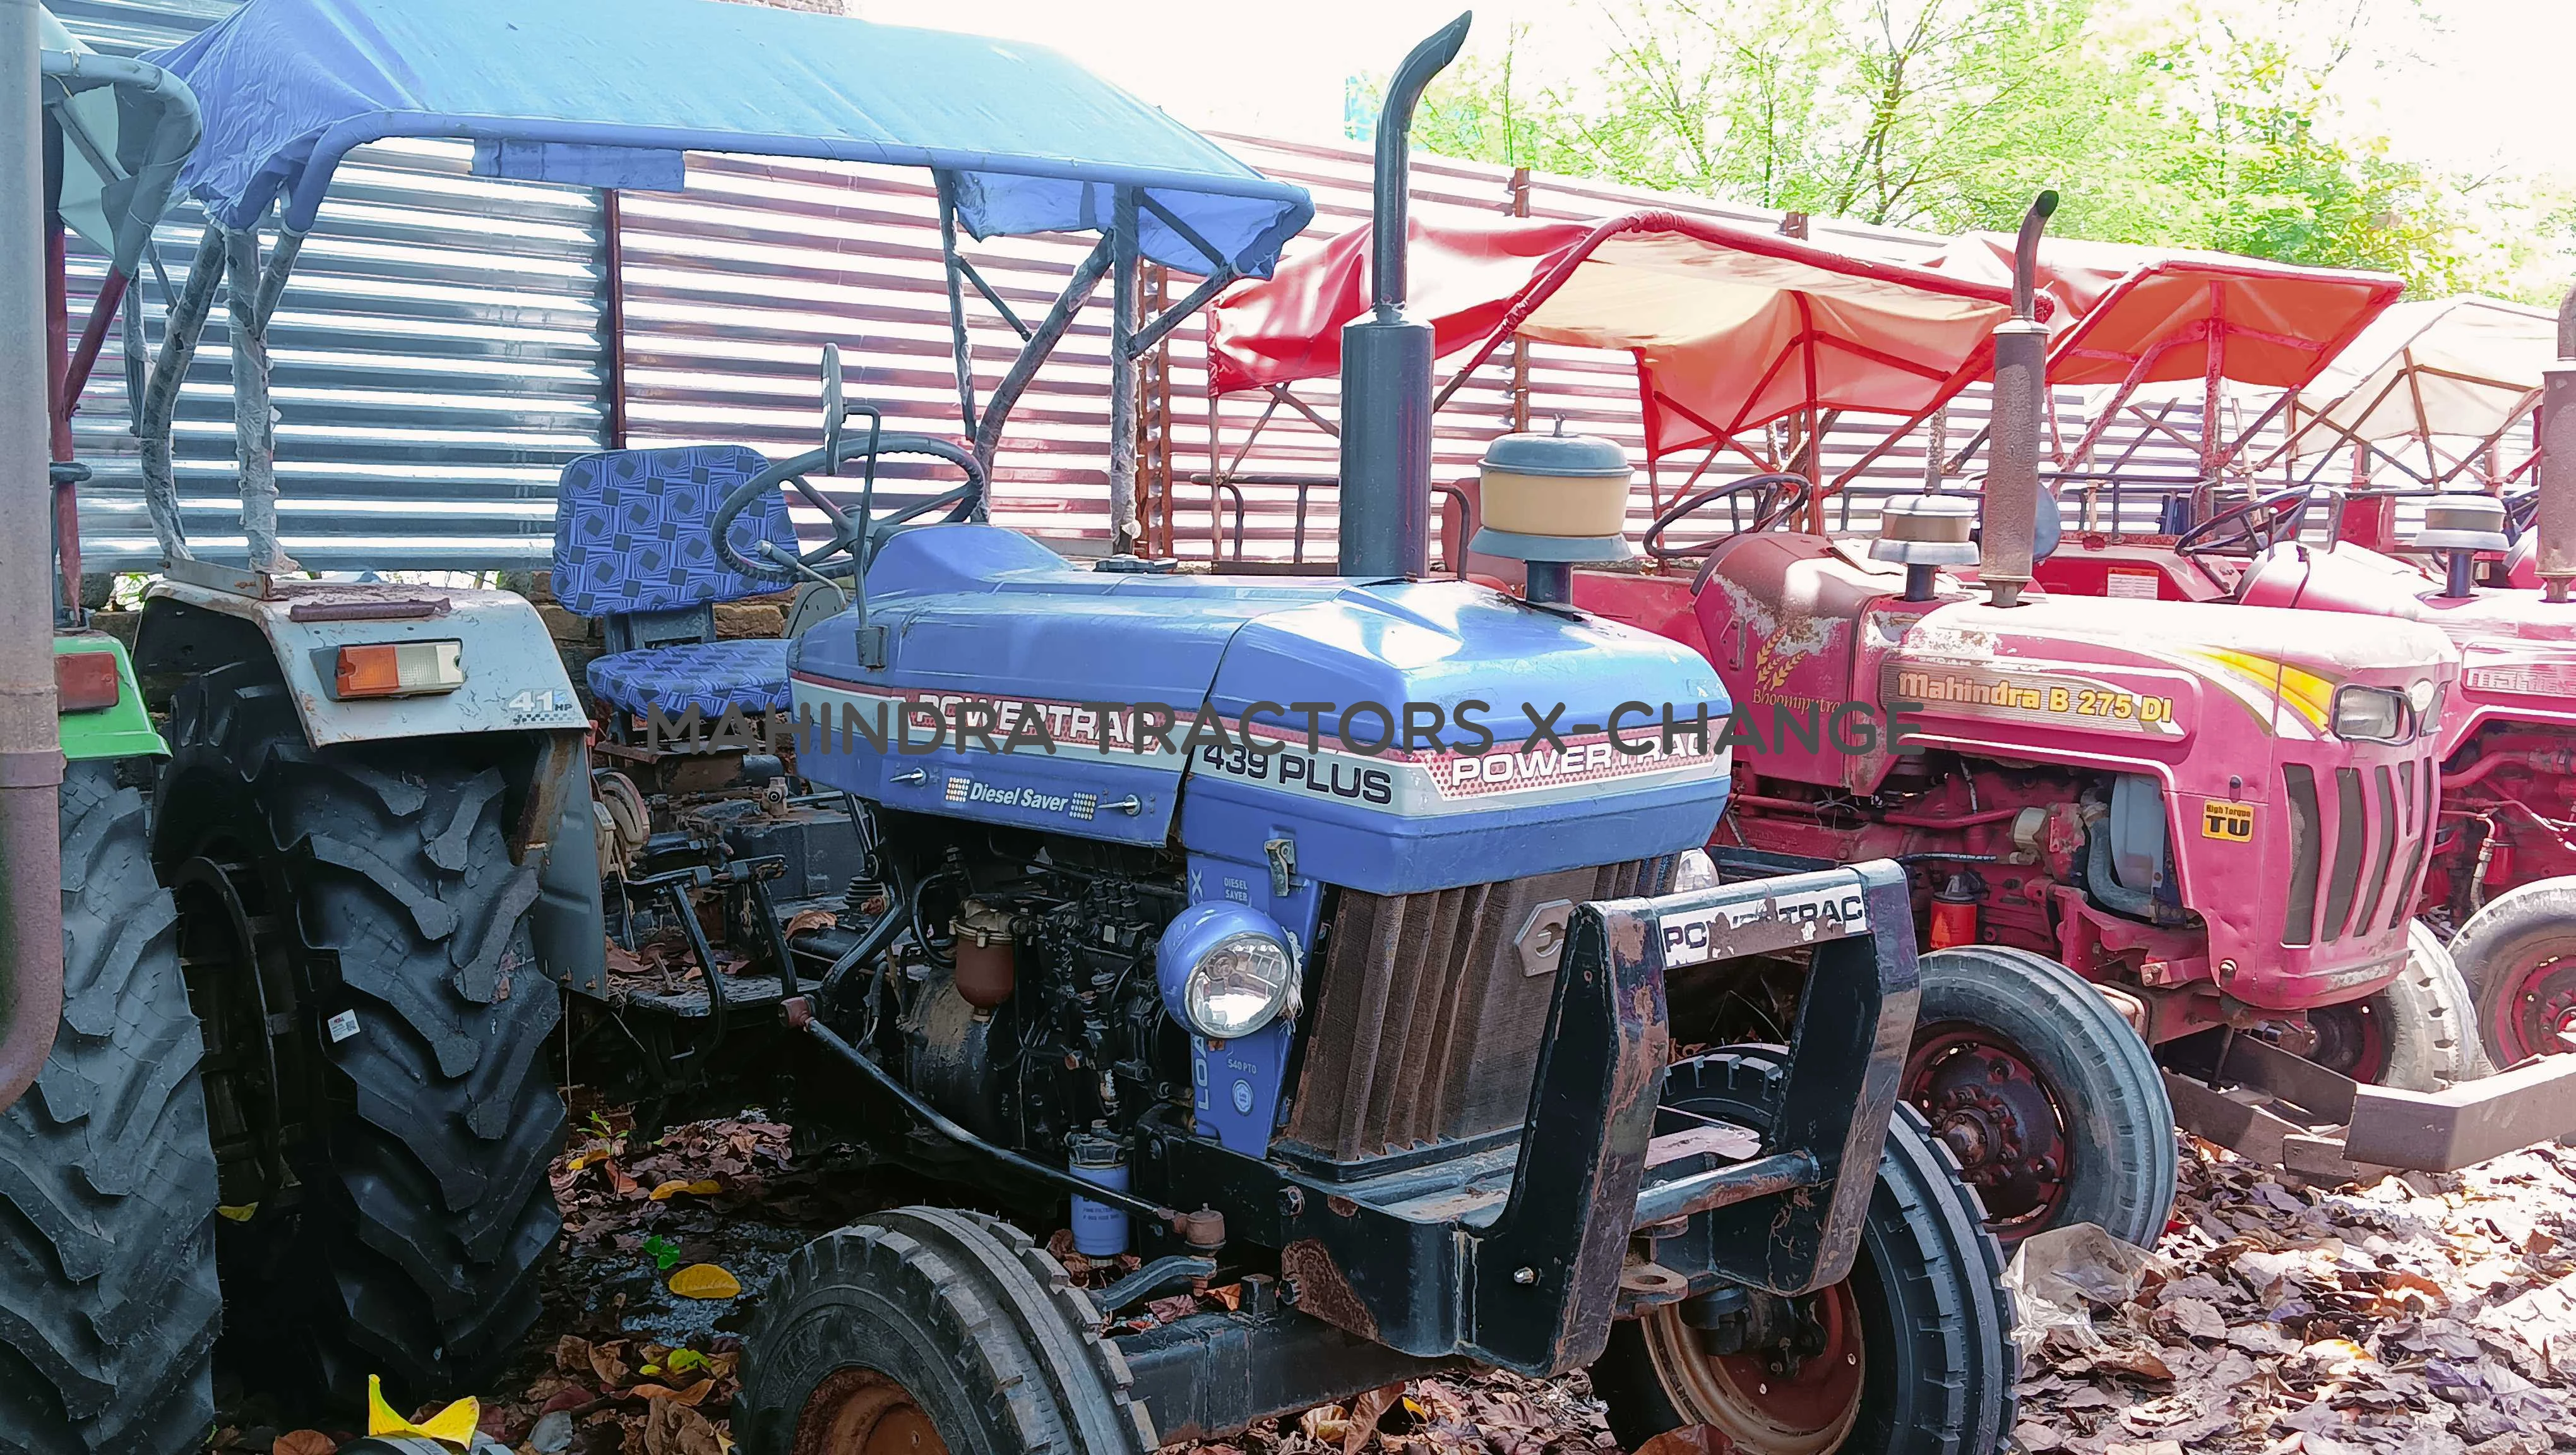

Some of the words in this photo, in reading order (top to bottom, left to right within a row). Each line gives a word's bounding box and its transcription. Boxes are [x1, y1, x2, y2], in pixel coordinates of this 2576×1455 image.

[509, 689, 553, 712] 41
[1899, 671, 2041, 710] Mahindra
[2049, 686, 2070, 712] B
[2077, 689, 2133, 719] 275
[2140, 695, 2173, 723] DI
[1203, 744, 1268, 779] 439
[1279, 753, 1392, 805] PLUS
[969, 782, 1020, 806] Diesel
[1020, 788, 1069, 812] Saver
[2205, 815, 2251, 837] TU
[1224, 877, 1248, 890] DIESEL
[1225, 889, 1248, 902] SAVER
[1663, 895, 1863, 952] POTRAC
[1227, 1058, 1242, 1070] 540
[1243, 1062, 1257, 1075] PTO
